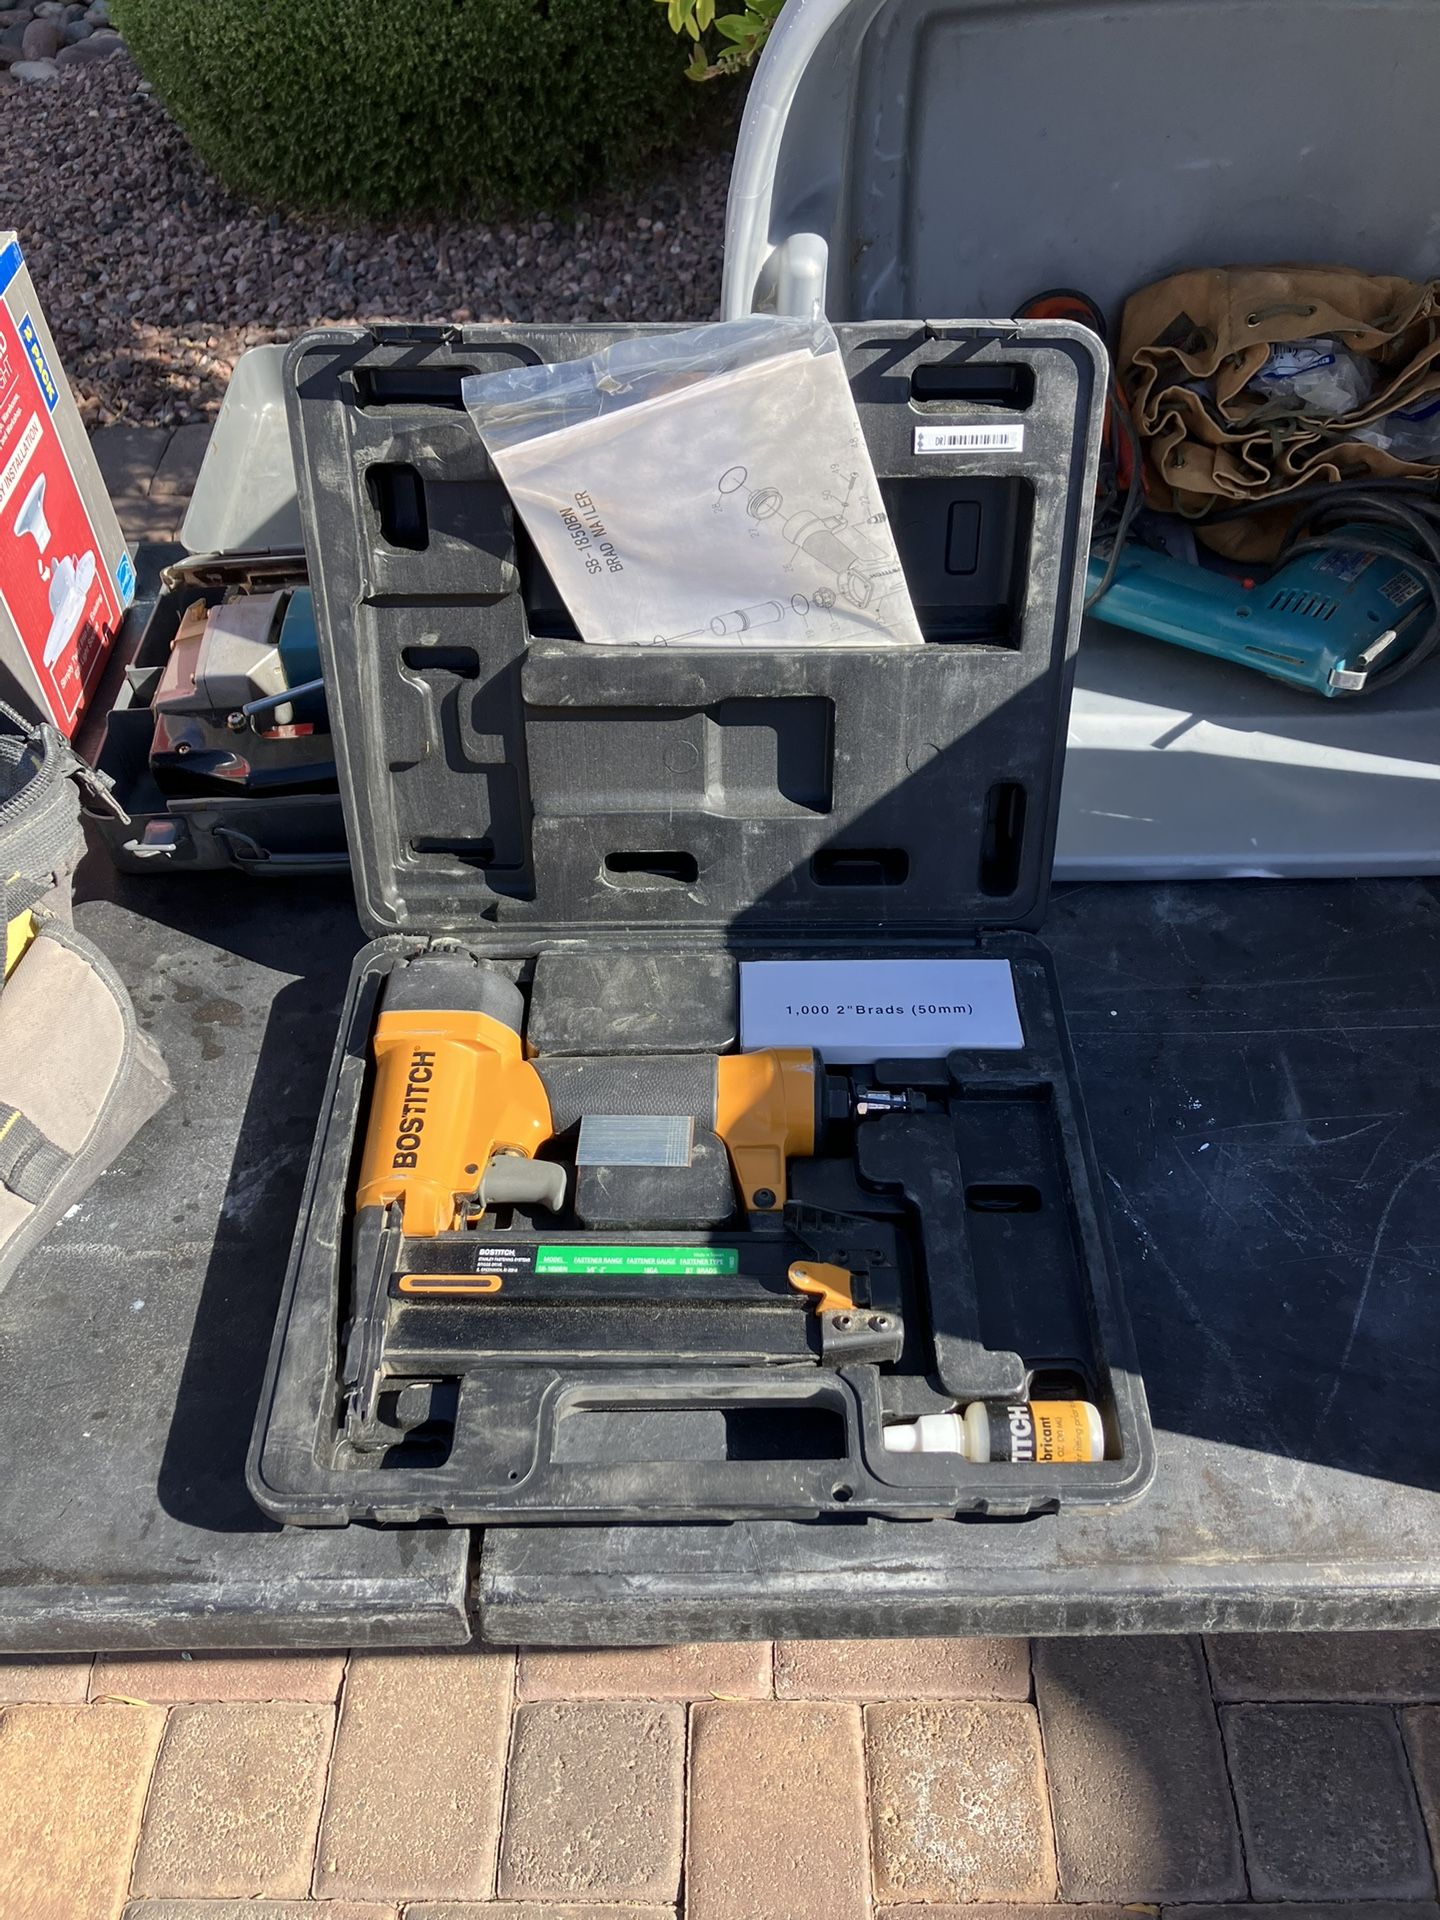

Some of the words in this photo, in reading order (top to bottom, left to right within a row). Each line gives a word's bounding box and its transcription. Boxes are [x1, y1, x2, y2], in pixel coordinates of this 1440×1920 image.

[24, 325, 32, 342] 2
[31, 343, 55, 402] PACK
[4, 421, 39, 489] INSTALLATION
[574, 489, 607, 538] NAILER
[560, 507, 602, 575] SB-1850BN
[599, 542, 624, 573] BRAD
[786, 1004, 829, 1017] 1,000
[912, 1003, 973, 1016] (50mm)
[392, 1051, 436, 1168] BOSTITCH
[543, 1256, 564, 1264] MODEL
[1040, 1416, 1053, 1462] bricant
